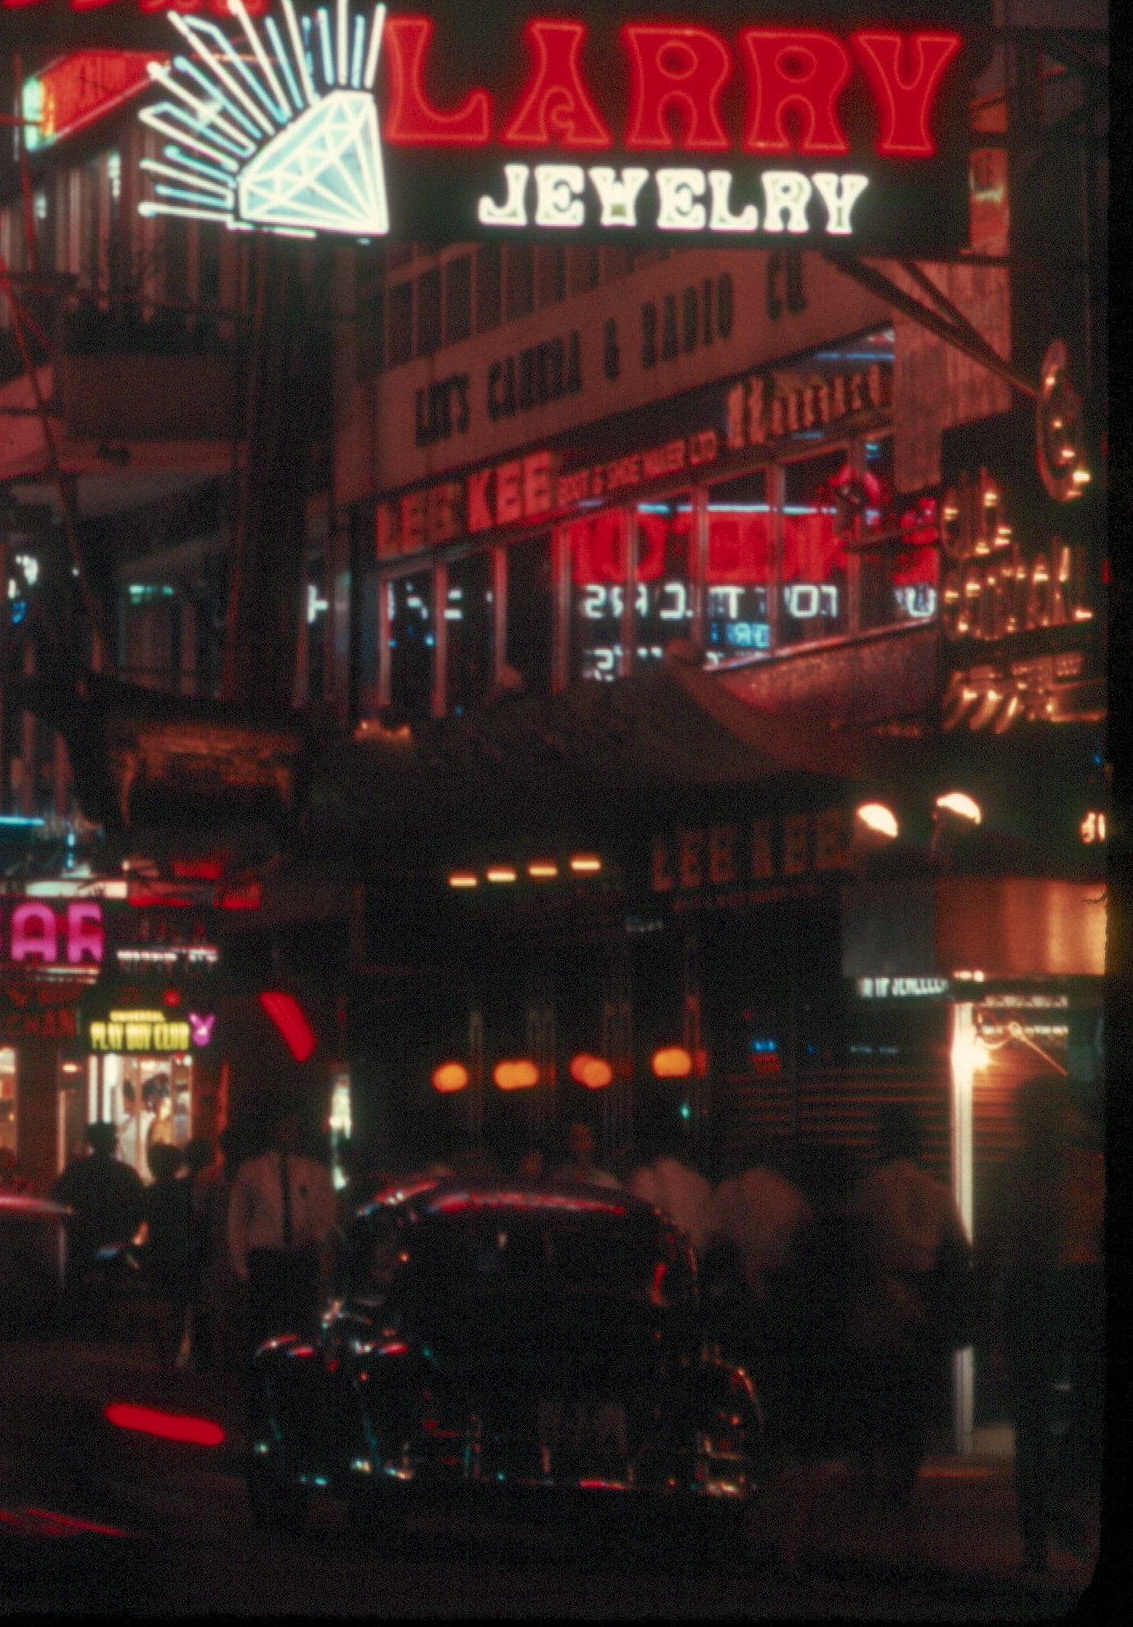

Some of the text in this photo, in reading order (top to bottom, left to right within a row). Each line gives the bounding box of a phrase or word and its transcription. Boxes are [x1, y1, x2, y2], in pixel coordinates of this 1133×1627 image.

[383, 13, 963, 158] LARRY
[478, 163, 869, 234] JEWELRY
[641, 271, 734, 371] RADIO
[374, 482, 462, 560] LEE
[466, 448, 553, 536] KEE
